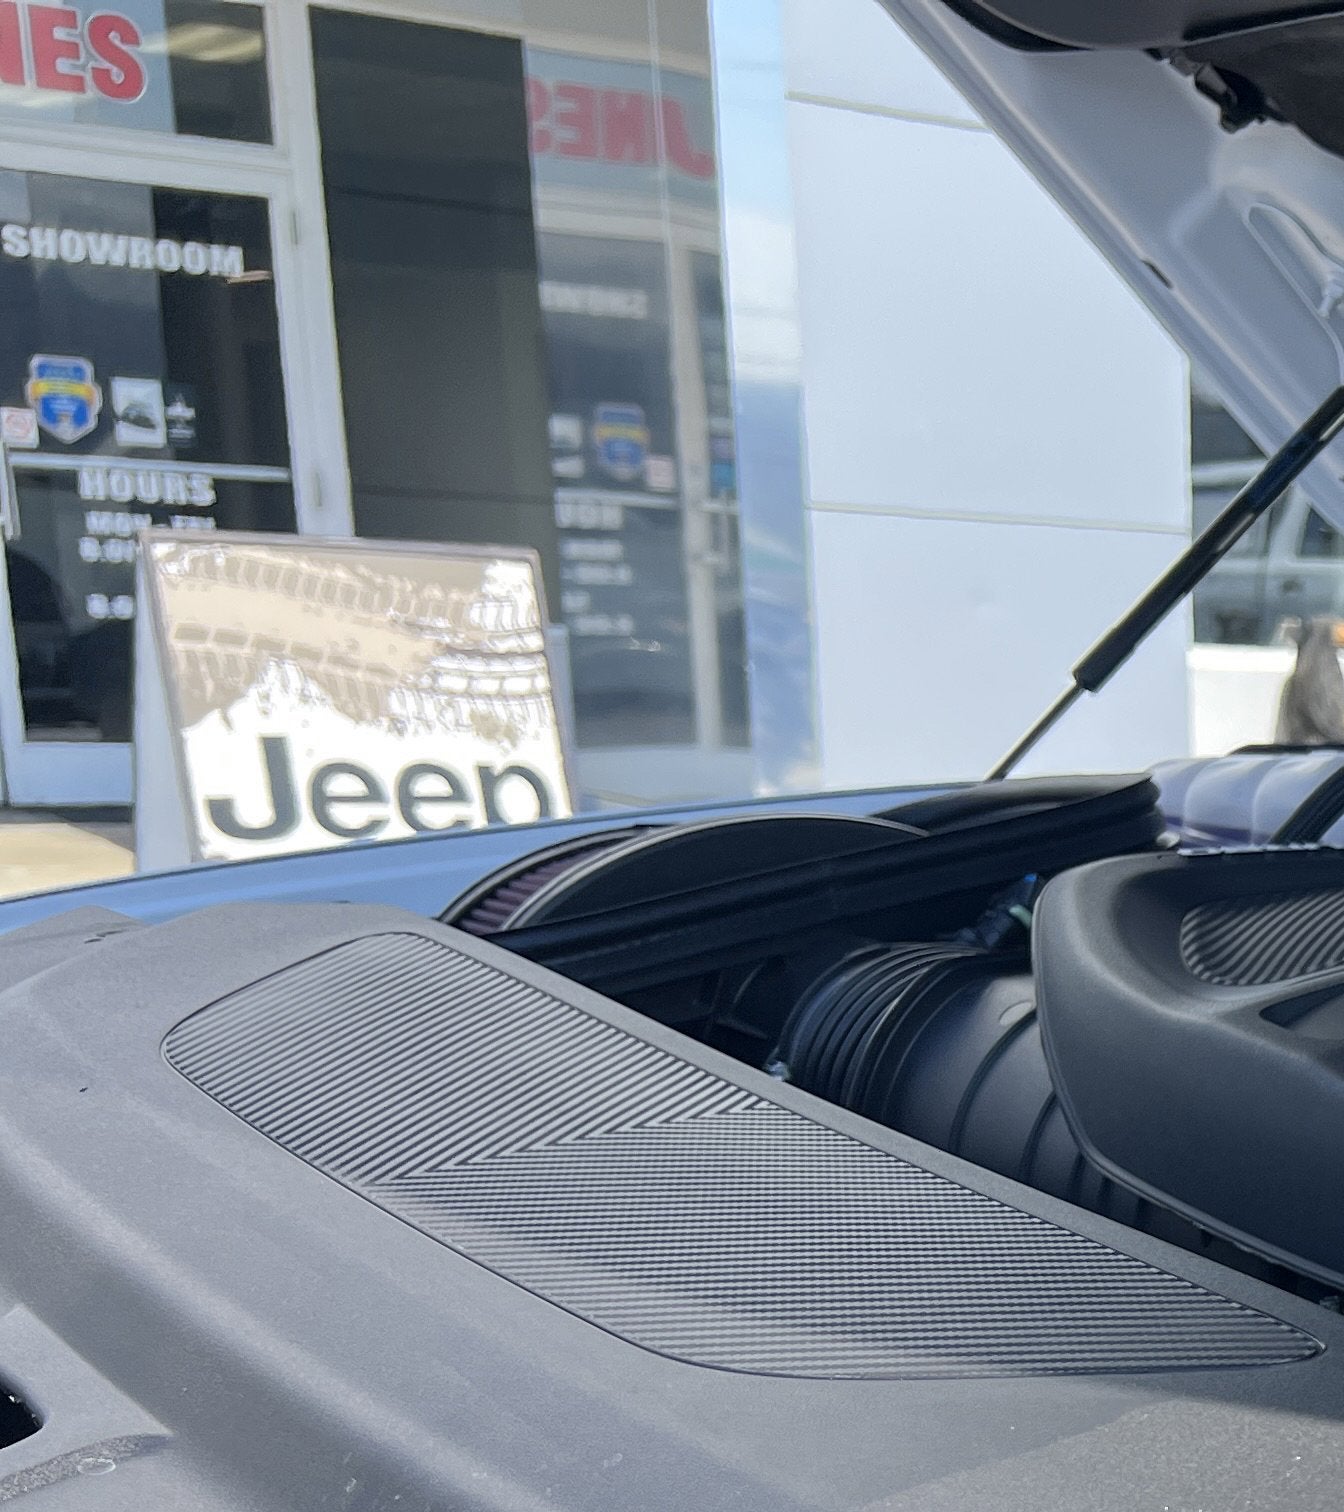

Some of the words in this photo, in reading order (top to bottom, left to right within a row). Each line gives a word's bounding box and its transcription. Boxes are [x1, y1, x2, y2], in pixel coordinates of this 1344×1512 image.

[1, 223, 244, 278] SHOWROOM
[79, 467, 217, 507] HOURS
[206, 736, 551, 841] Jeep
